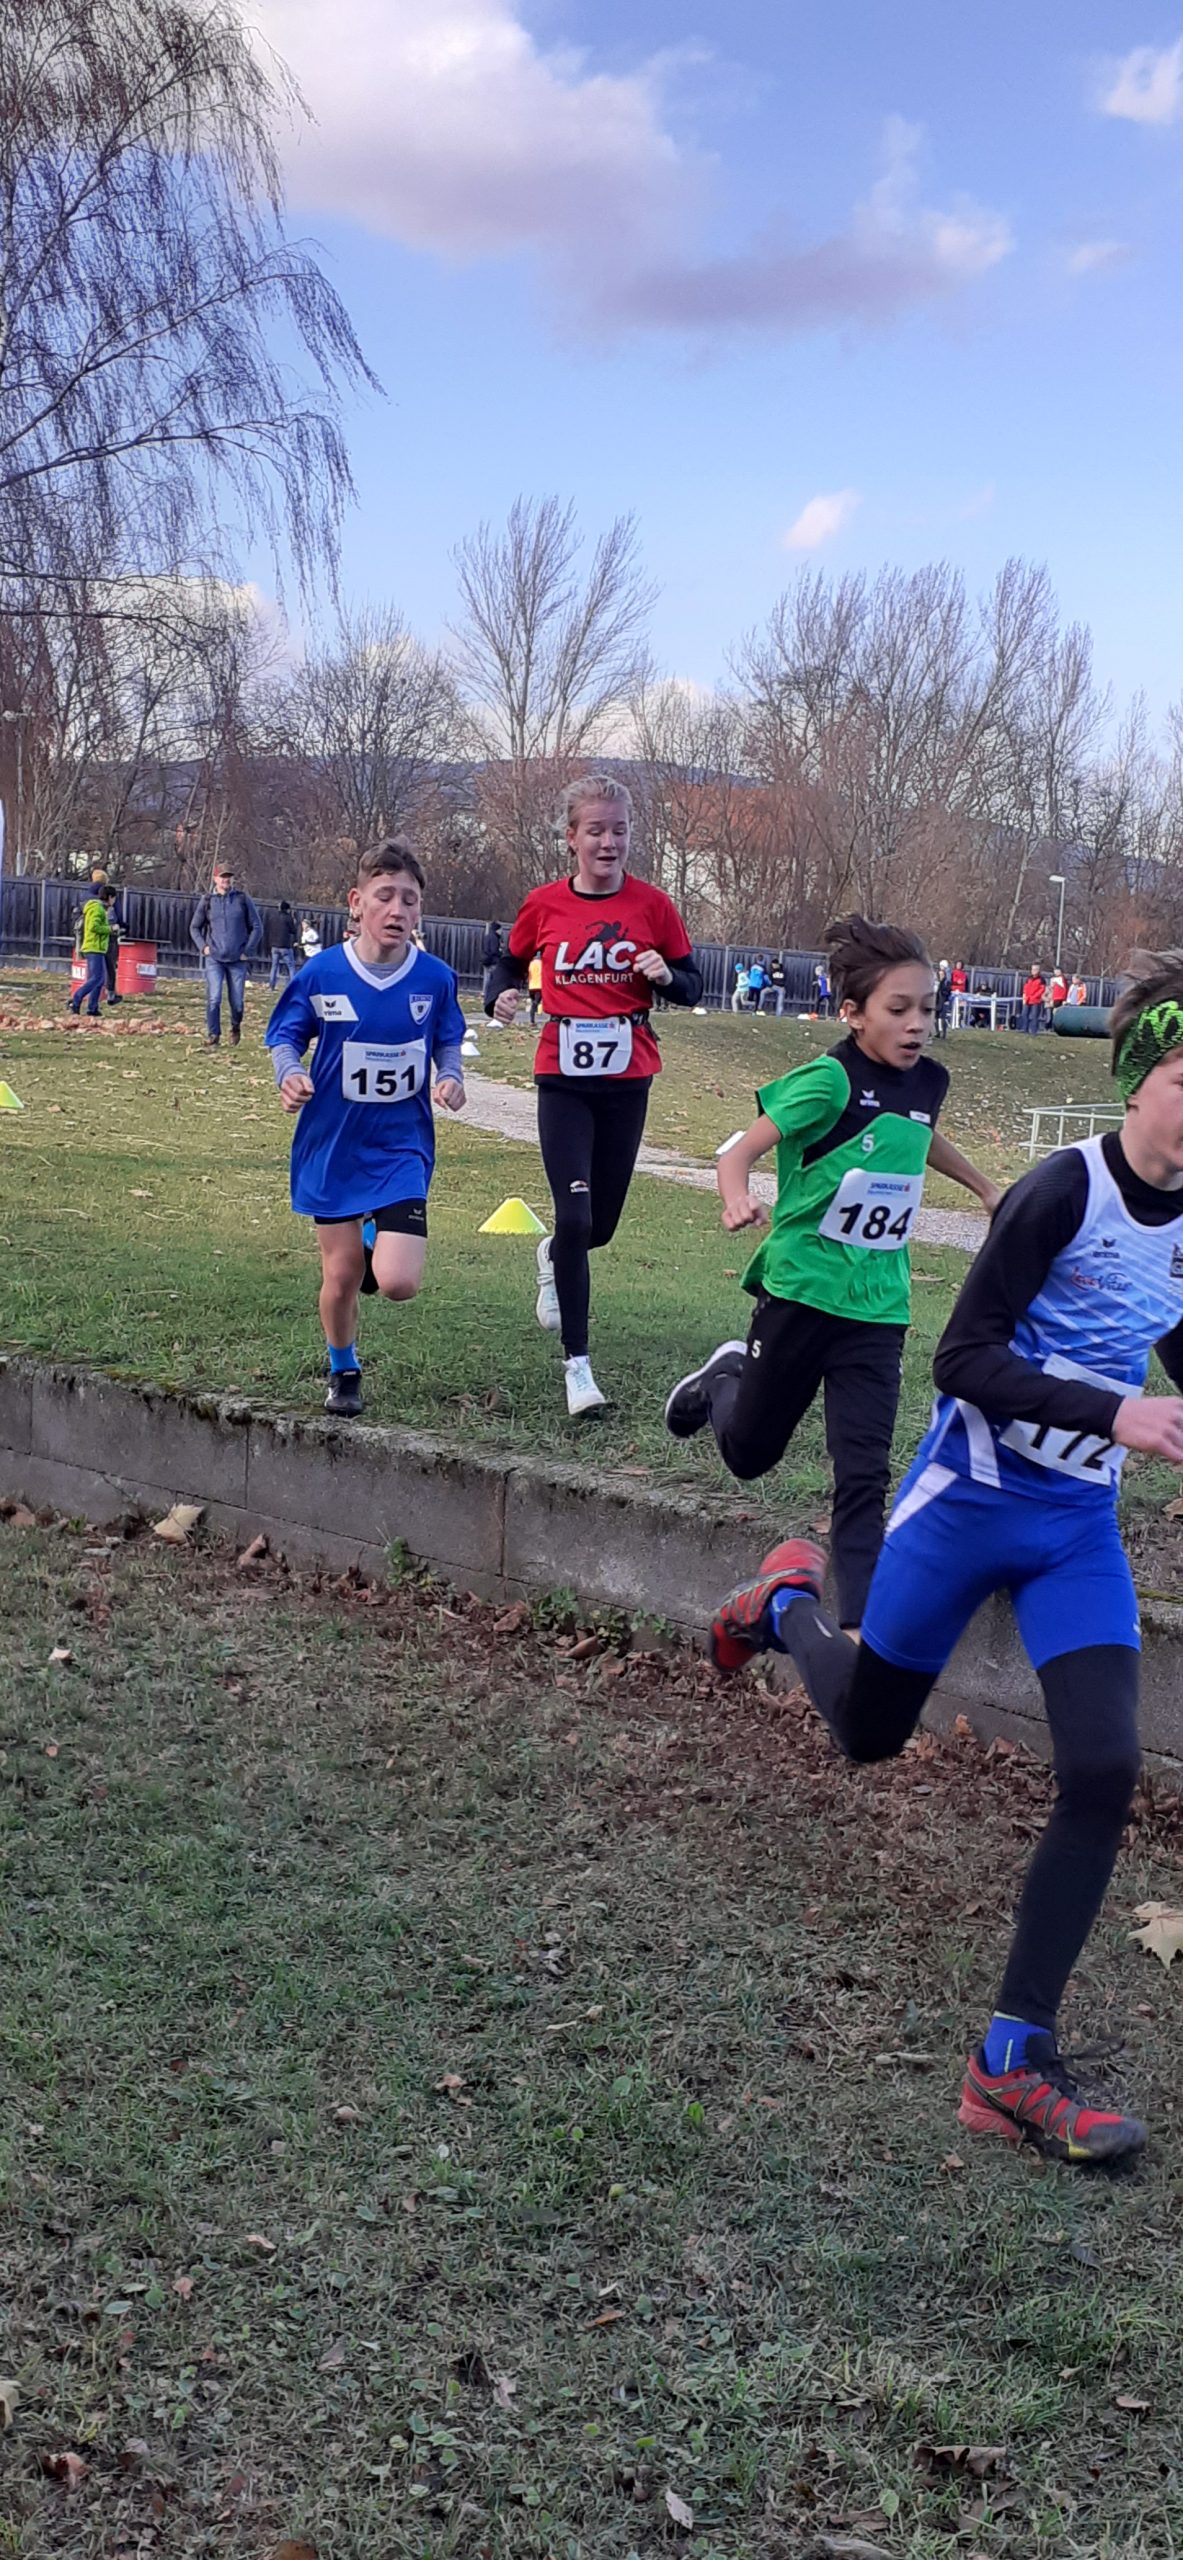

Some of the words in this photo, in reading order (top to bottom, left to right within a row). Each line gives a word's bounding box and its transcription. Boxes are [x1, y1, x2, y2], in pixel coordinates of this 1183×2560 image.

[554, 941, 637, 970] LAC
[555, 972, 634, 985] KLAGENFURT
[573, 1041, 619, 1069] 87
[350, 1064, 416, 1097] 151
[861, 1133, 874, 1152] 5
[839, 1203, 913, 1241] 184
[751, 1339, 761, 1358] 5
